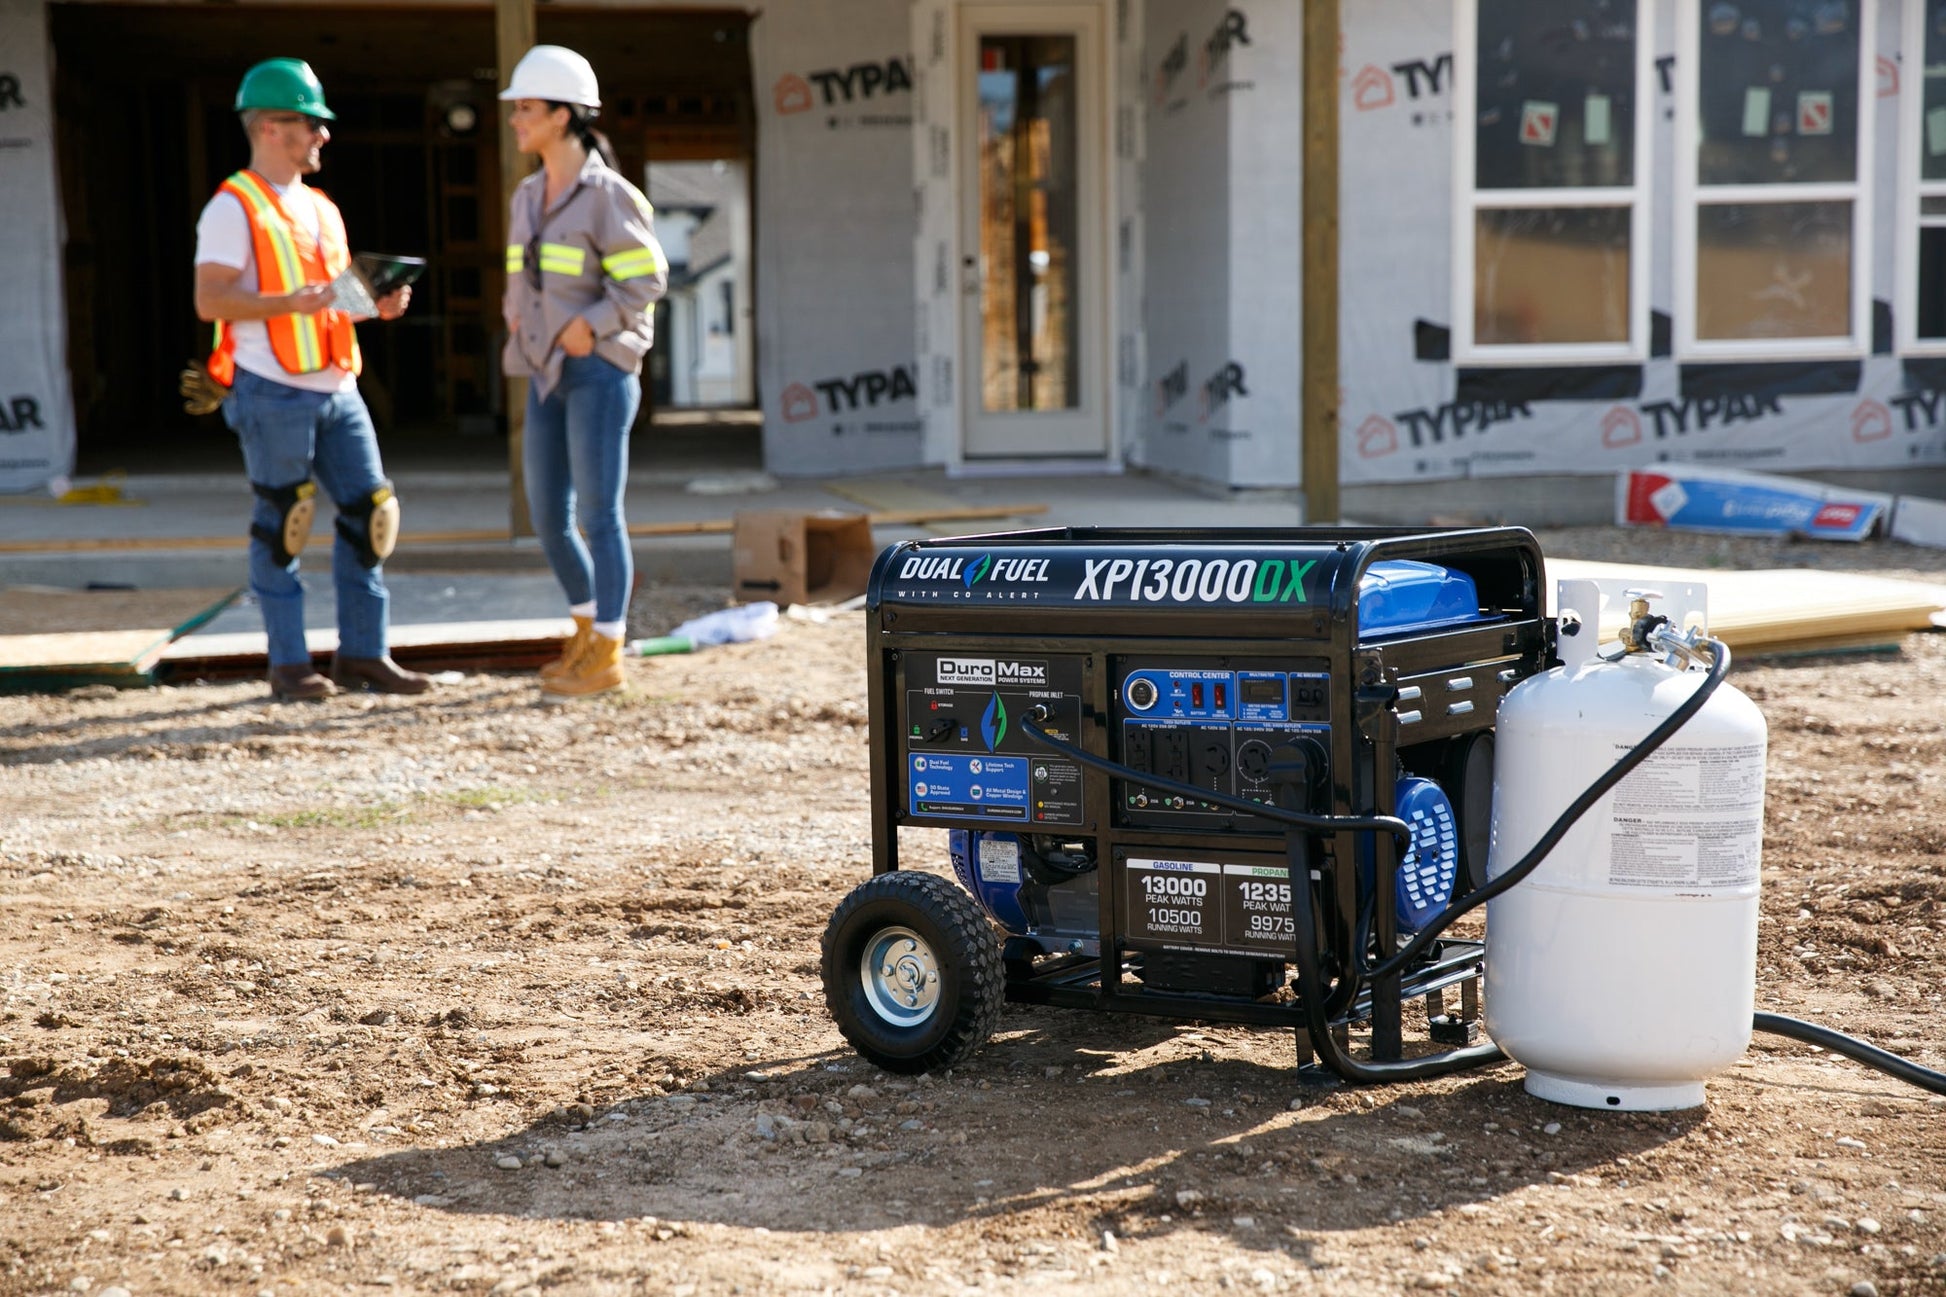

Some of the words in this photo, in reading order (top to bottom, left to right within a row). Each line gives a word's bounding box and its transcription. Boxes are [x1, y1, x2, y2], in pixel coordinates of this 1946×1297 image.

[808, 53, 914, 104] TYPA
[1391, 51, 1453, 99] TY
[814, 363, 917, 412] TYPA
[900, 557, 964, 580] DUAL
[990, 558, 1050, 582] FUEL
[1073, 559, 1317, 602] XP13000DX
[898, 590, 938, 598] WITH
[1152, 861, 1194, 871] GASOLINE
[1252, 868, 1289, 878] PROPAN
[1141, 876, 1206, 897] 13000
[1146, 894, 1170, 904] PEAK
[1170, 896, 1203, 906] WATTS
[1243, 901, 1268, 911] PEAK
[1149, 908, 1201, 926] 10500
[1251, 916, 1295, 933] 9975
[1147, 923, 1178, 933] RUNNING
[1179, 924, 1202, 934] WATTS
[1245, 930, 1276, 940] RUNNING
